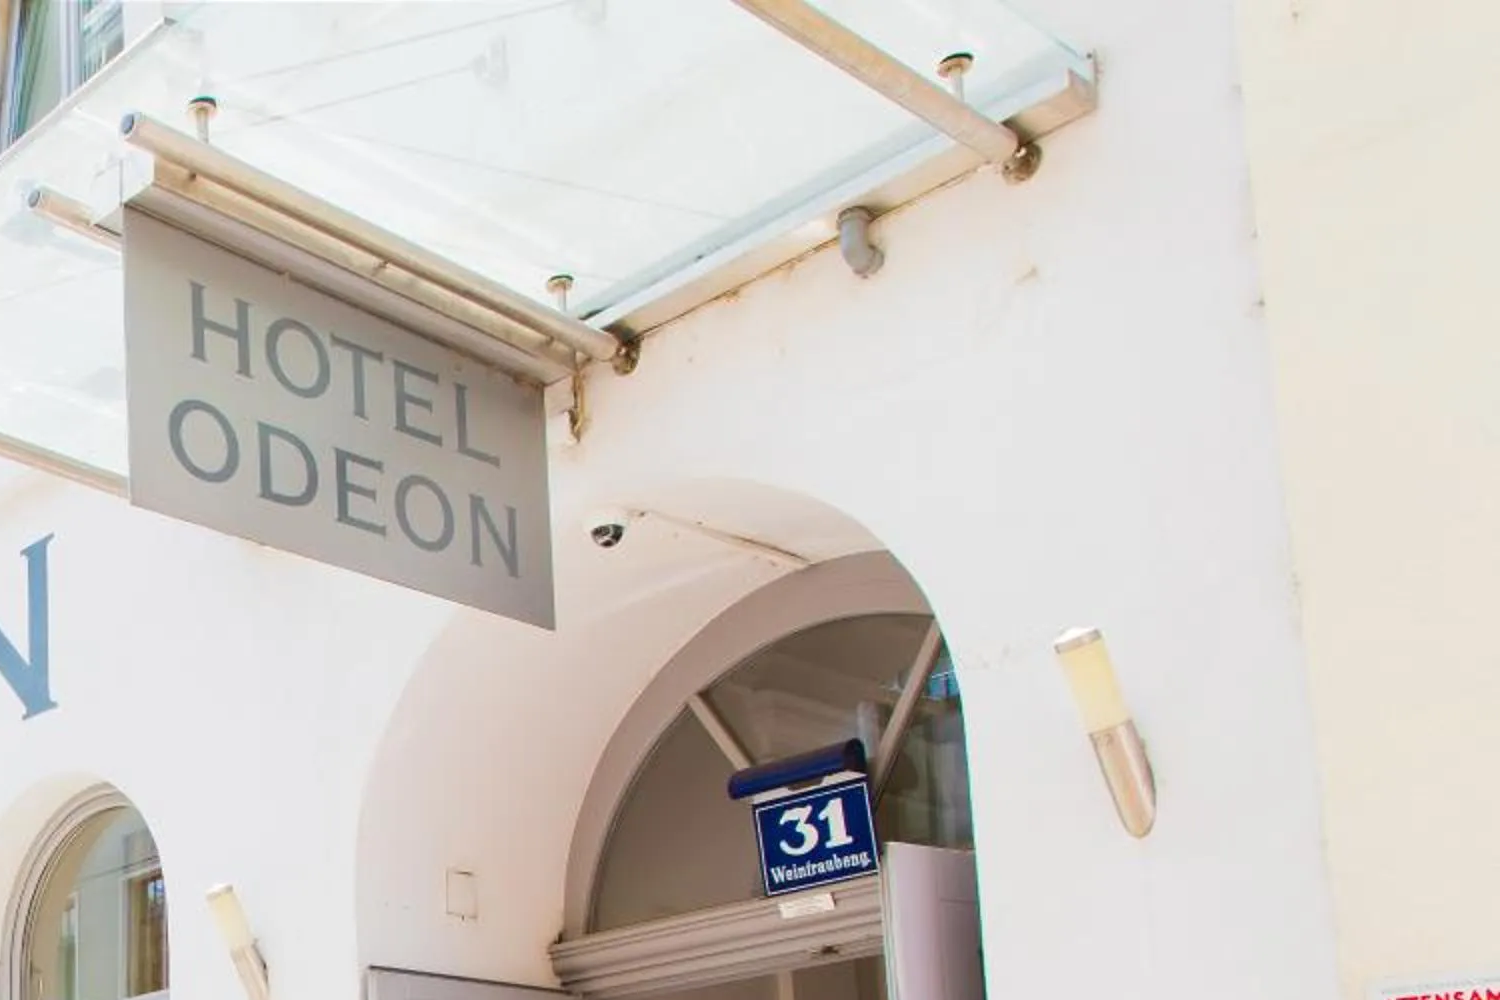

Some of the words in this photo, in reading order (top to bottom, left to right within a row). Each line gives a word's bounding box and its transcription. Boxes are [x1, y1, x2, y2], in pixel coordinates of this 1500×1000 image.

[189, 279, 500, 469] HOTEL
[168, 398, 520, 579] ODEON
[779, 798, 853, 856] 31
